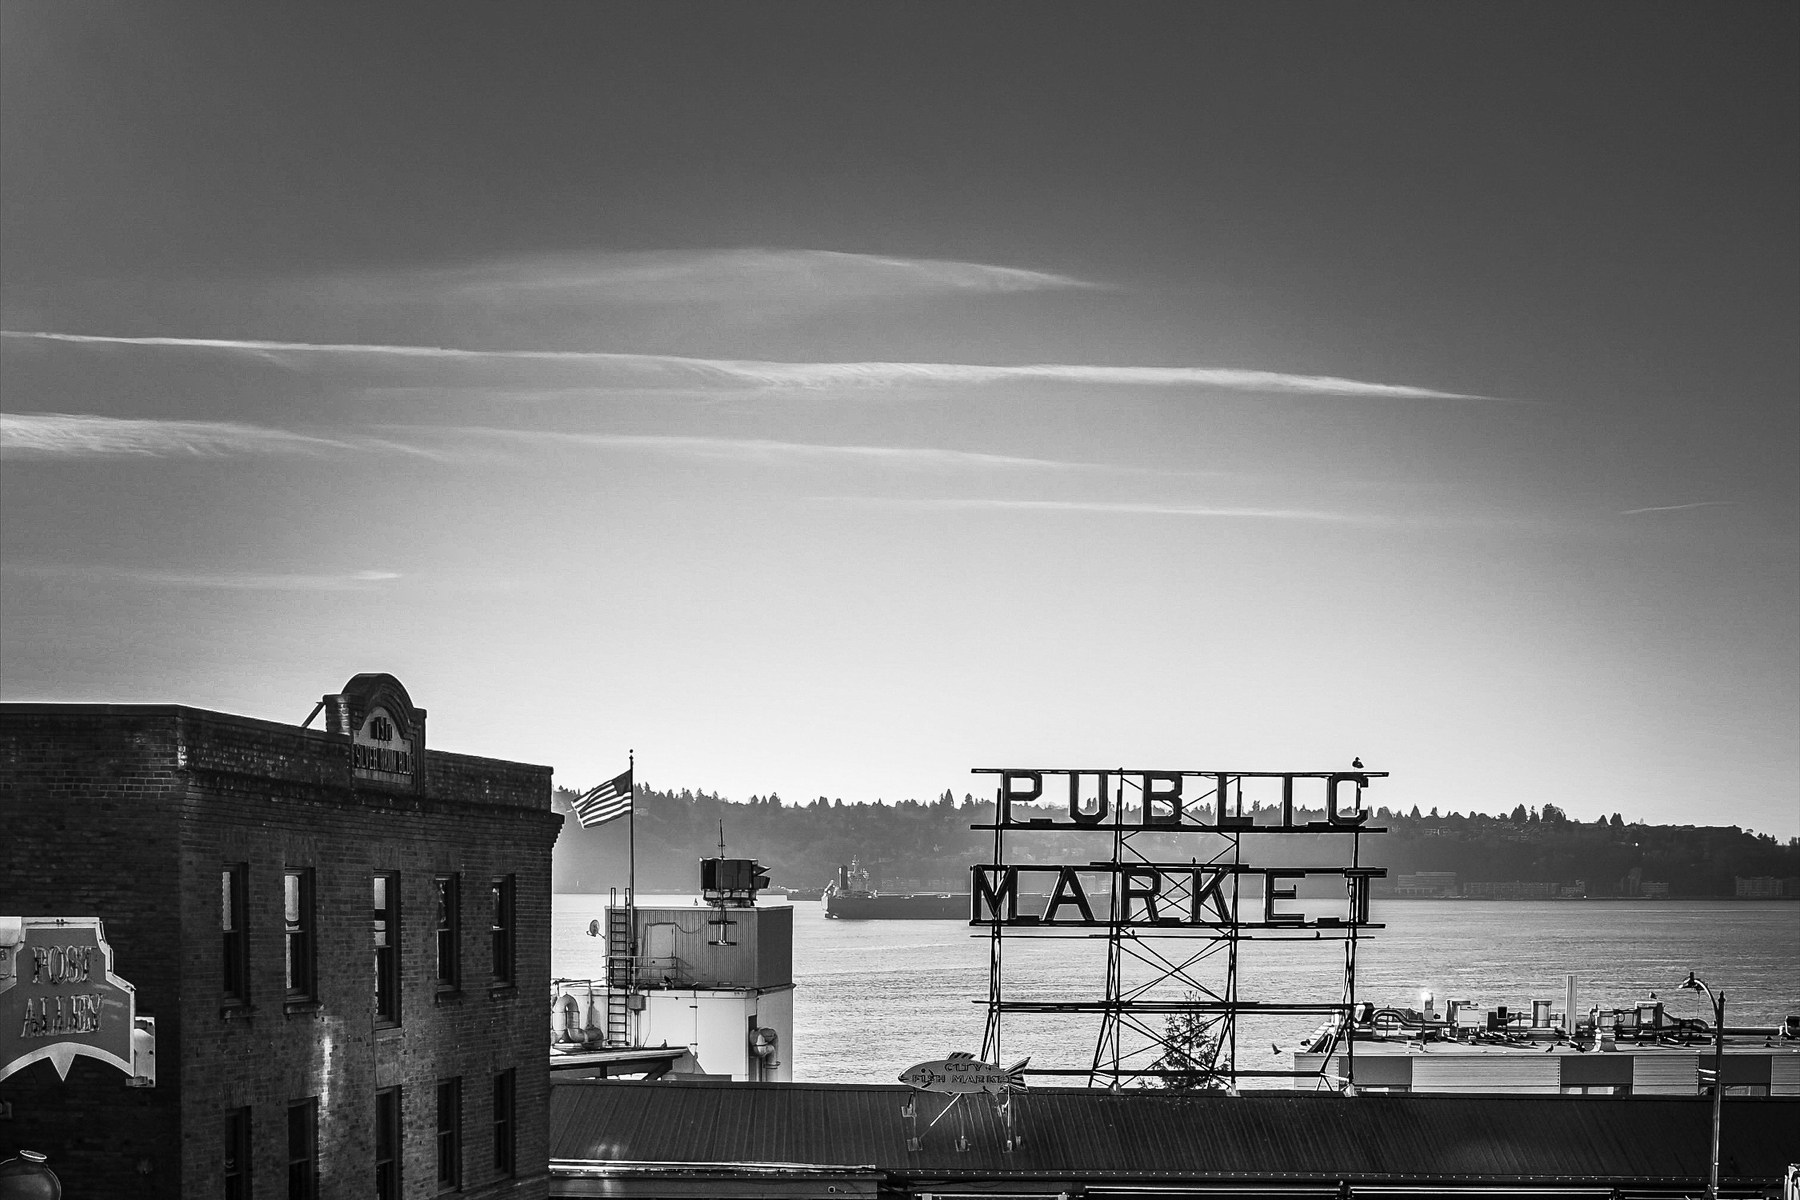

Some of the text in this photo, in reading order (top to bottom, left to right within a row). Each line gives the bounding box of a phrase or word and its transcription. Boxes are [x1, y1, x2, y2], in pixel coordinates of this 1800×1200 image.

[1003, 770, 1369, 827] PUBLIC
[972, 866, 1388, 922] MARKET
[32, 945, 97, 984] POST
[20, 993, 104, 1038] ALLEY
[912, 1074, 946, 1083] FISH
[944, 1063, 983, 1072] CITY
